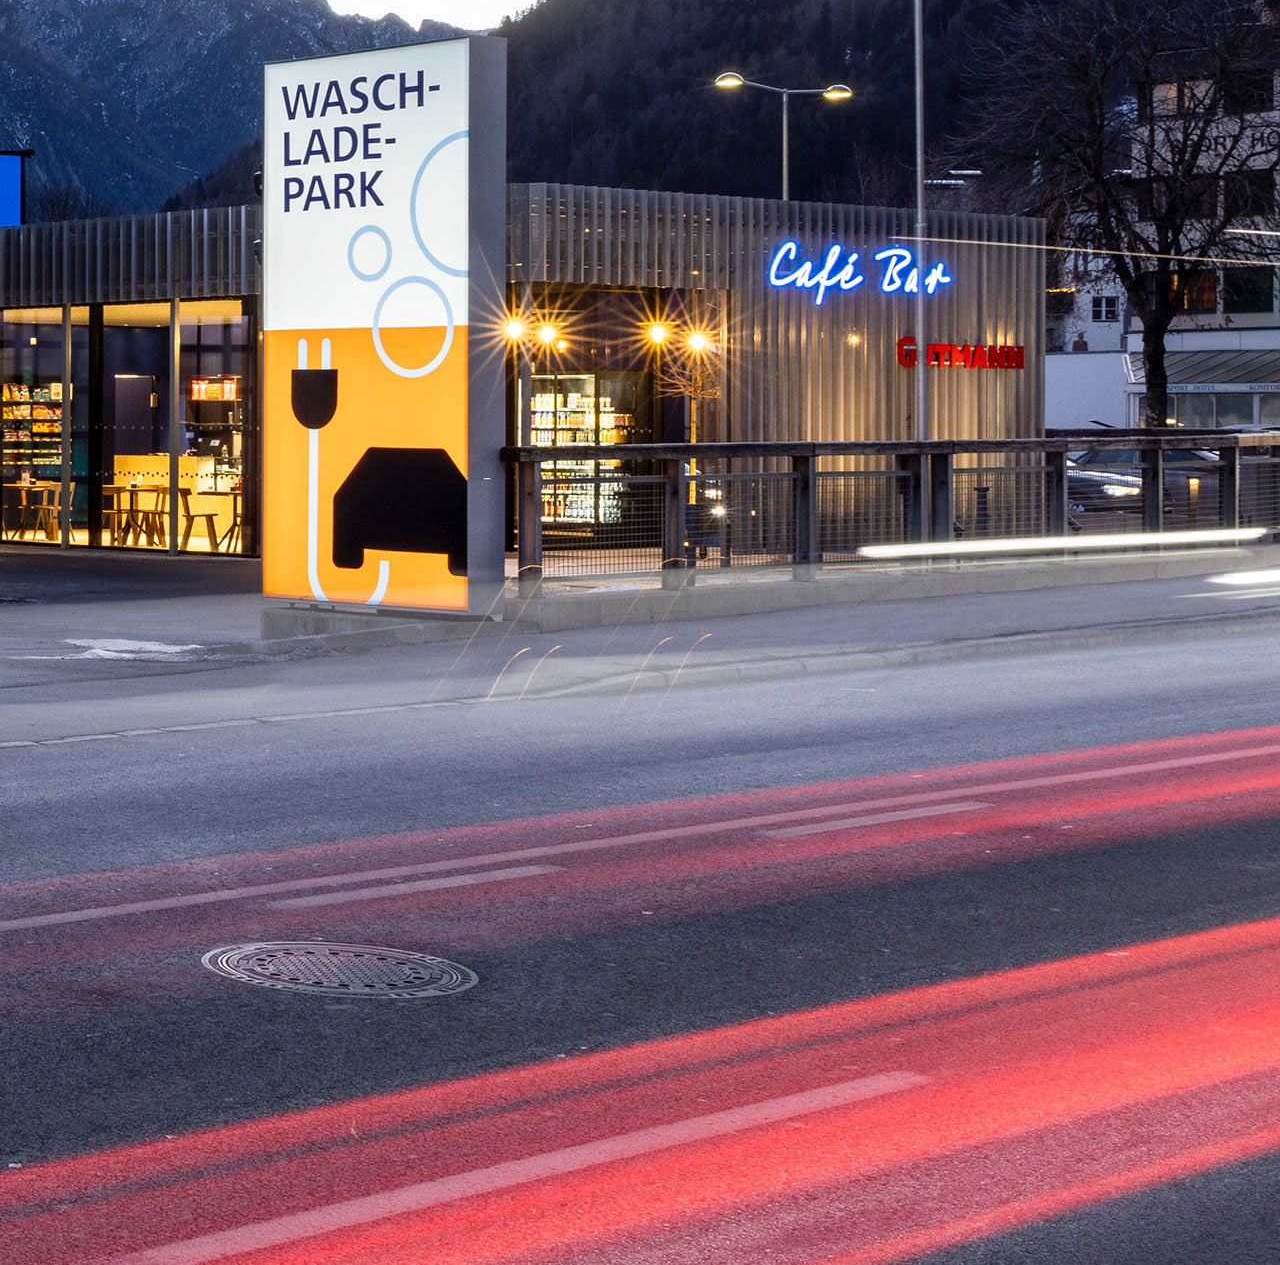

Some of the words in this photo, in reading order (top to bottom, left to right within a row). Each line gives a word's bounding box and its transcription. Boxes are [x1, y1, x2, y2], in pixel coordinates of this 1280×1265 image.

[281, 69, 440, 120] WASCH-
[283, 122, 397, 167] LADE-
[283, 170, 385, 213] PARK
[769, 241, 864, 306] Café
[874, 248, 952, 295] Bar
